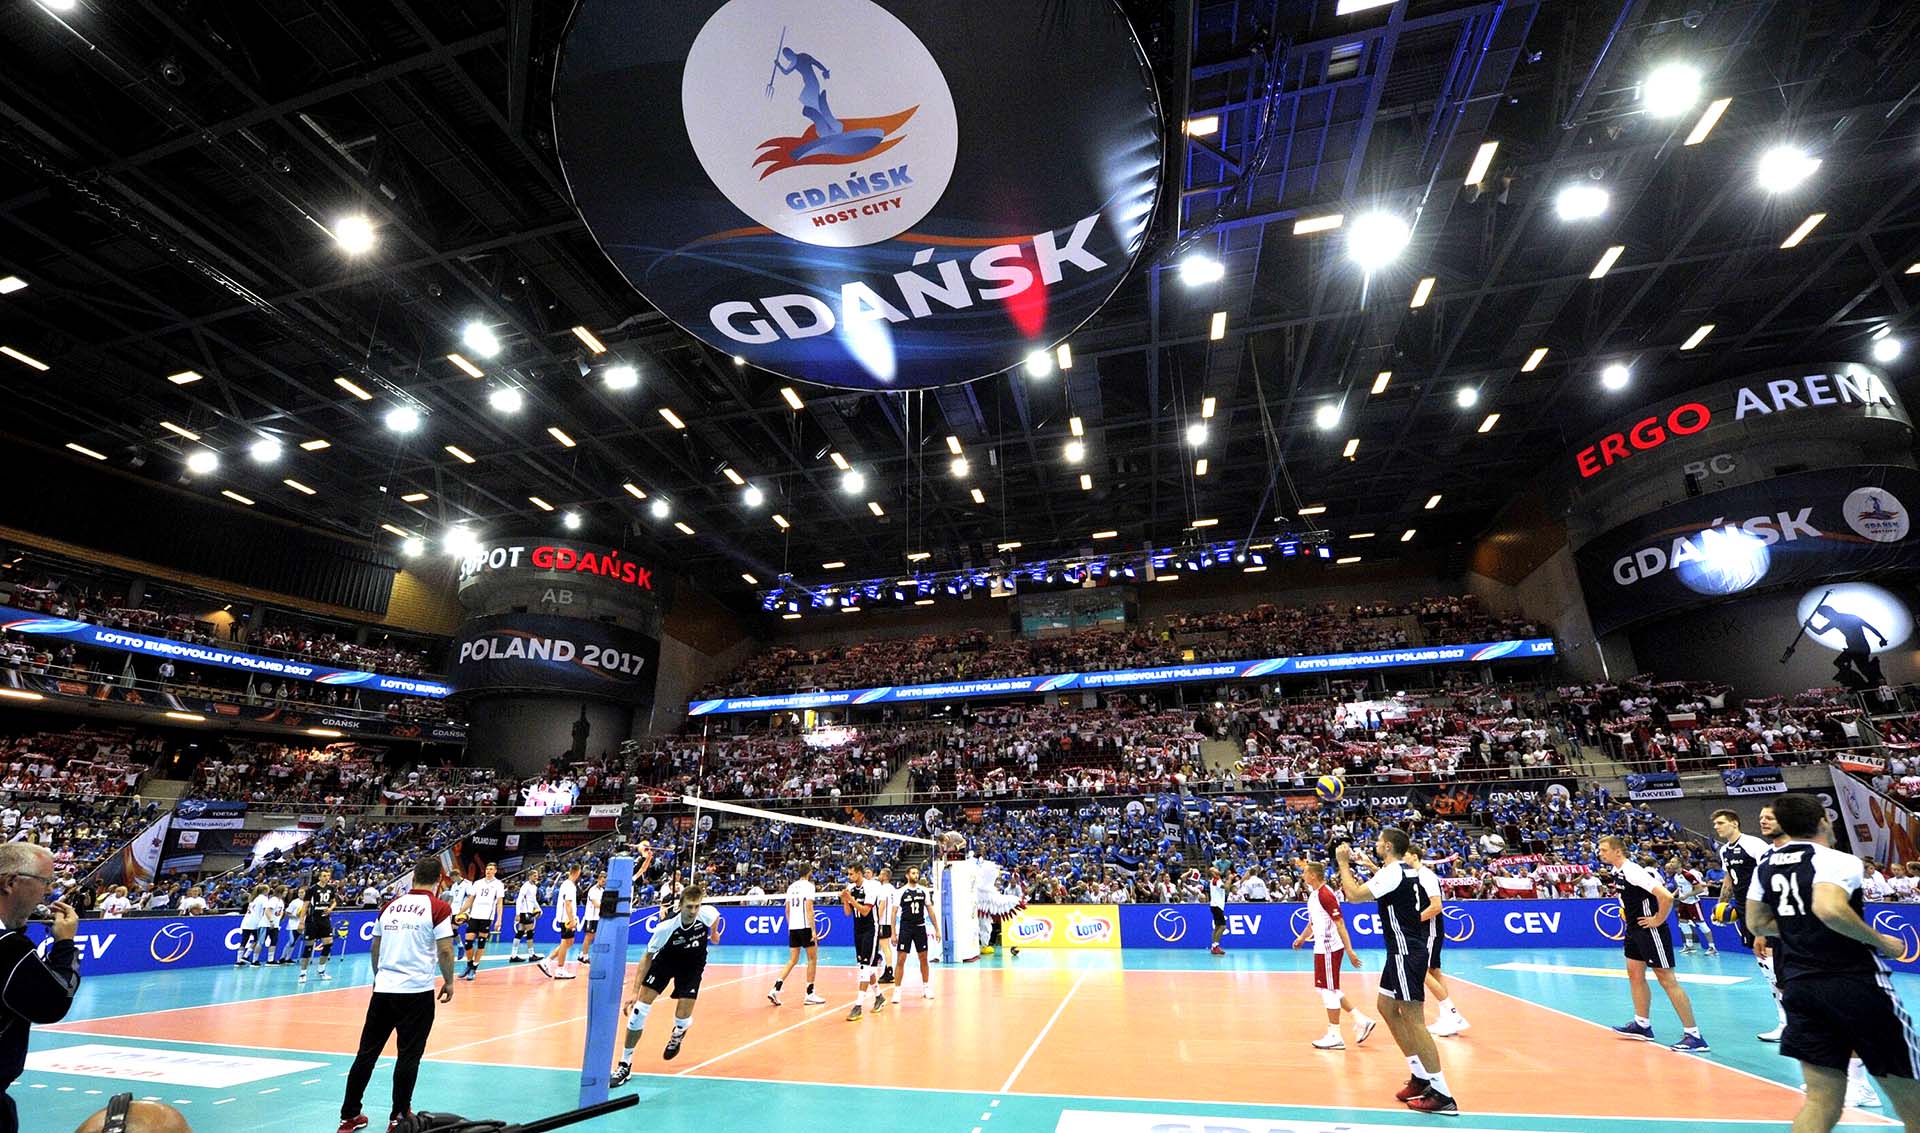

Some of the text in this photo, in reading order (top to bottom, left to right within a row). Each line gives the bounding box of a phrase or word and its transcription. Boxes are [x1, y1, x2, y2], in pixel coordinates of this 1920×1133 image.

[785, 164, 914, 211] GDAŃSK
[811, 196, 902, 228] HOST CITY
[709, 215, 1107, 344] GDAŃSK
[1575, 373, 1896, 478] ERGO ARENA
[531, 545, 654, 590] GDAŃSK
[541, 588, 574, 605] AB
[95, 631, 313, 677] LOTTO EUROVOLLEY POLAND 2017
[459, 637, 645, 676] POLAND 2017
[1295, 649, 1464, 669] LOTTO EUROVOLLEY POLAND 2017
[1085, 665, 1236, 684] LOTTO EUROVOLLEY POLAND 2017
[380, 679, 415, 692] LOTTO
[896, 681, 1032, 698] LOTTO EUROVOLLEY POLAND 2017
[727, 701, 751, 710] LOTTO
[322, 718, 360, 728] GDAŃSK
[432, 729, 466, 738] GDAŃSK
[1635, 790, 1678, 798] RAKVERE
[1736, 784, 1777, 793] TALLINN
[1382, 795, 1409, 805] 2017
[472, 834, 489, 845] POLAND
[319, 892, 330, 902] 10
[480, 888, 490, 897] 19
[1770, 872, 1806, 917] 21
[389, 904, 426, 917] POLSKA
[910, 901, 920, 914] 12
[744, 915, 784, 934] CEV
[1018, 922, 1044, 936] LOTTO
[1076, 922, 1103, 937] LOTTO
[1352, 914, 1384, 935] CE
[1503, 911, 1561, 934] CEV
